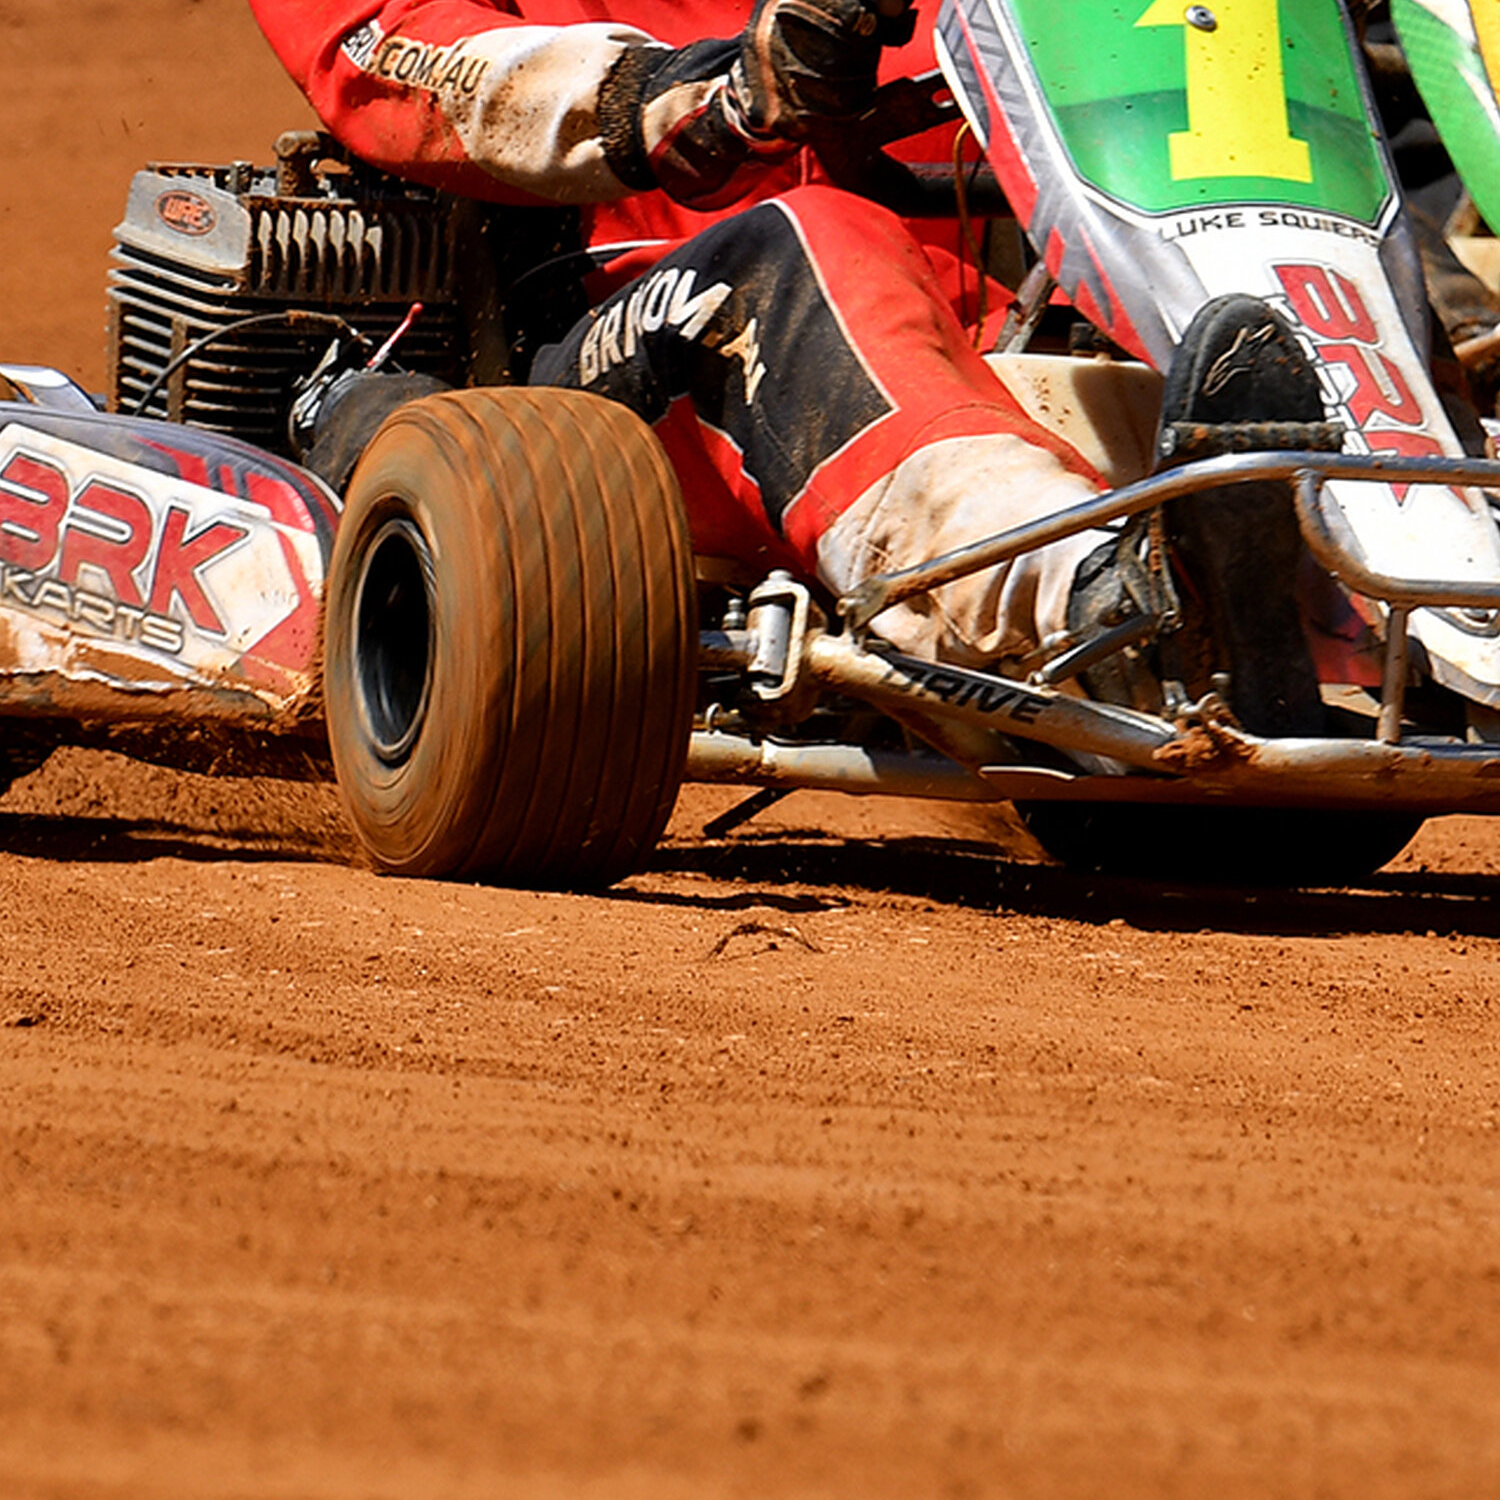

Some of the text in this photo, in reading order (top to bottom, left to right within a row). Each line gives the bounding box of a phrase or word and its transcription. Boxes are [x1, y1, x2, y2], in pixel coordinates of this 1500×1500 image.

[1158, 211, 1382, 248] LUKE SQUIERS
[0, 449, 251, 640] BRK
[2, 566, 184, 654] KARTS
